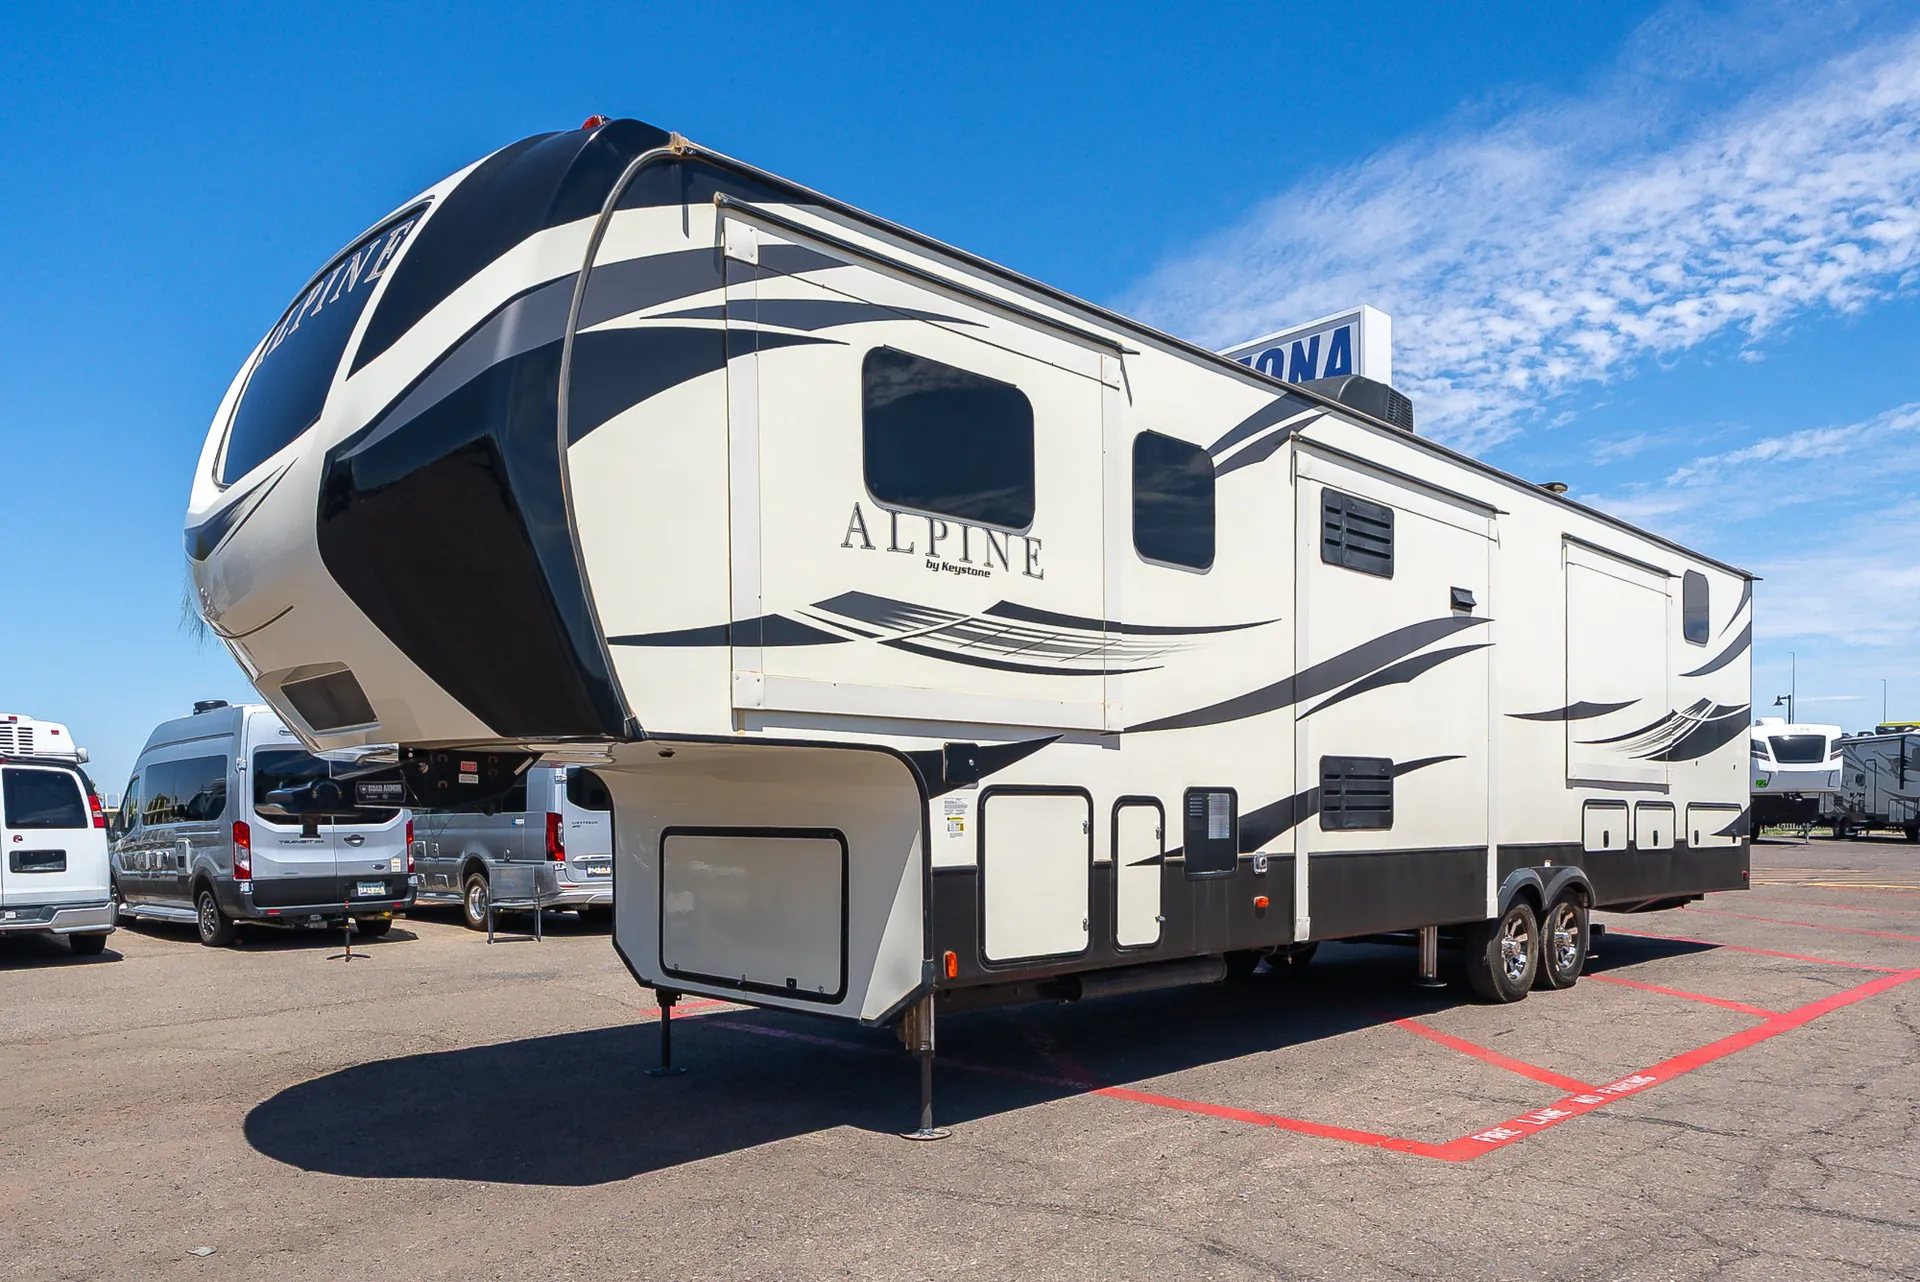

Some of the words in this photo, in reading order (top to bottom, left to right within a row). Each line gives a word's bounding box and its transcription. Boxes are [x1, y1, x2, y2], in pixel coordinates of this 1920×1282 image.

[1236, 325, 1353, 384] ONA
[840, 501, 1045, 581] ALPINE
[925, 559, 940, 573] by
[941, 561, 991, 578] Keystone
[368, 784, 383, 793] ROAD
[383, 784, 402, 793] ARMOR
[1469, 1126, 1523, 1143] FIRE
[1516, 1108, 1573, 1125] LANE
[1569, 1094, 1605, 1105] NO
